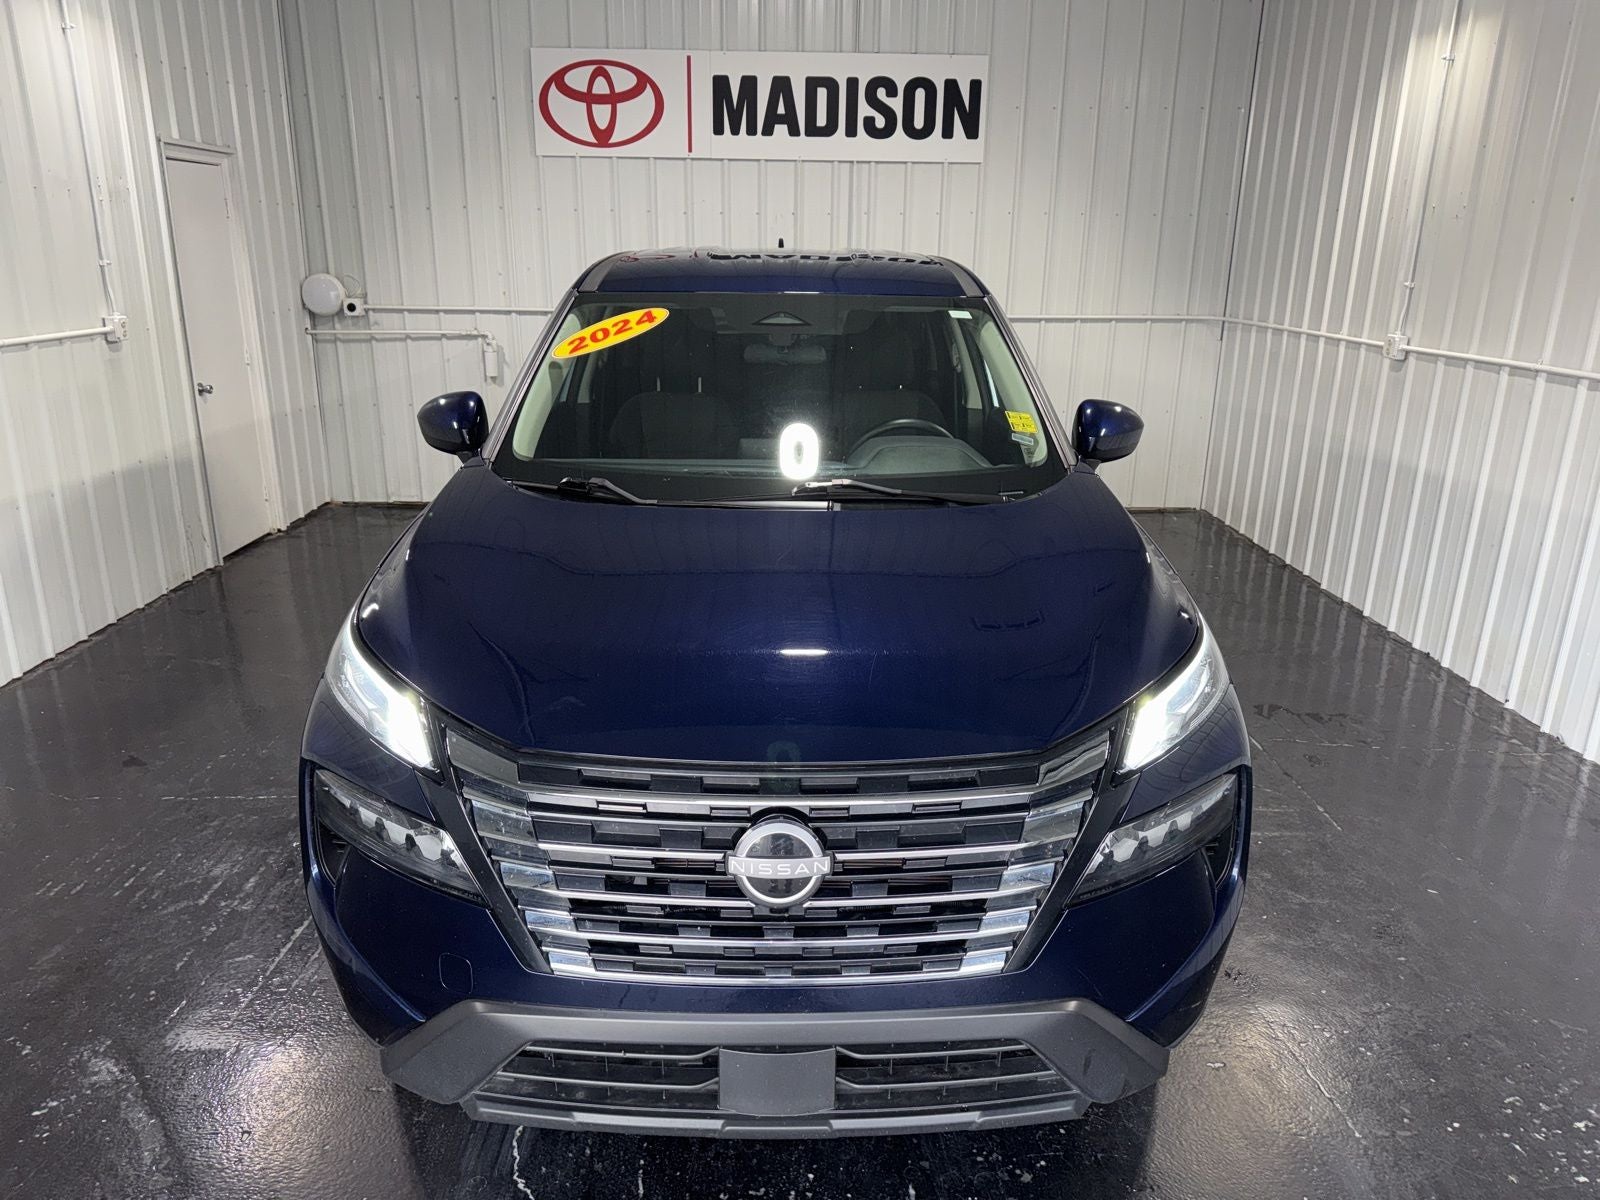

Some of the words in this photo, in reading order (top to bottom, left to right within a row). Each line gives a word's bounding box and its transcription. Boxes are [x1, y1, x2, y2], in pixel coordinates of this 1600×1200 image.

[712, 74, 982, 140] MADISON
[567, 310, 657, 355] 2024
[730, 860, 829, 875] NISSAN
